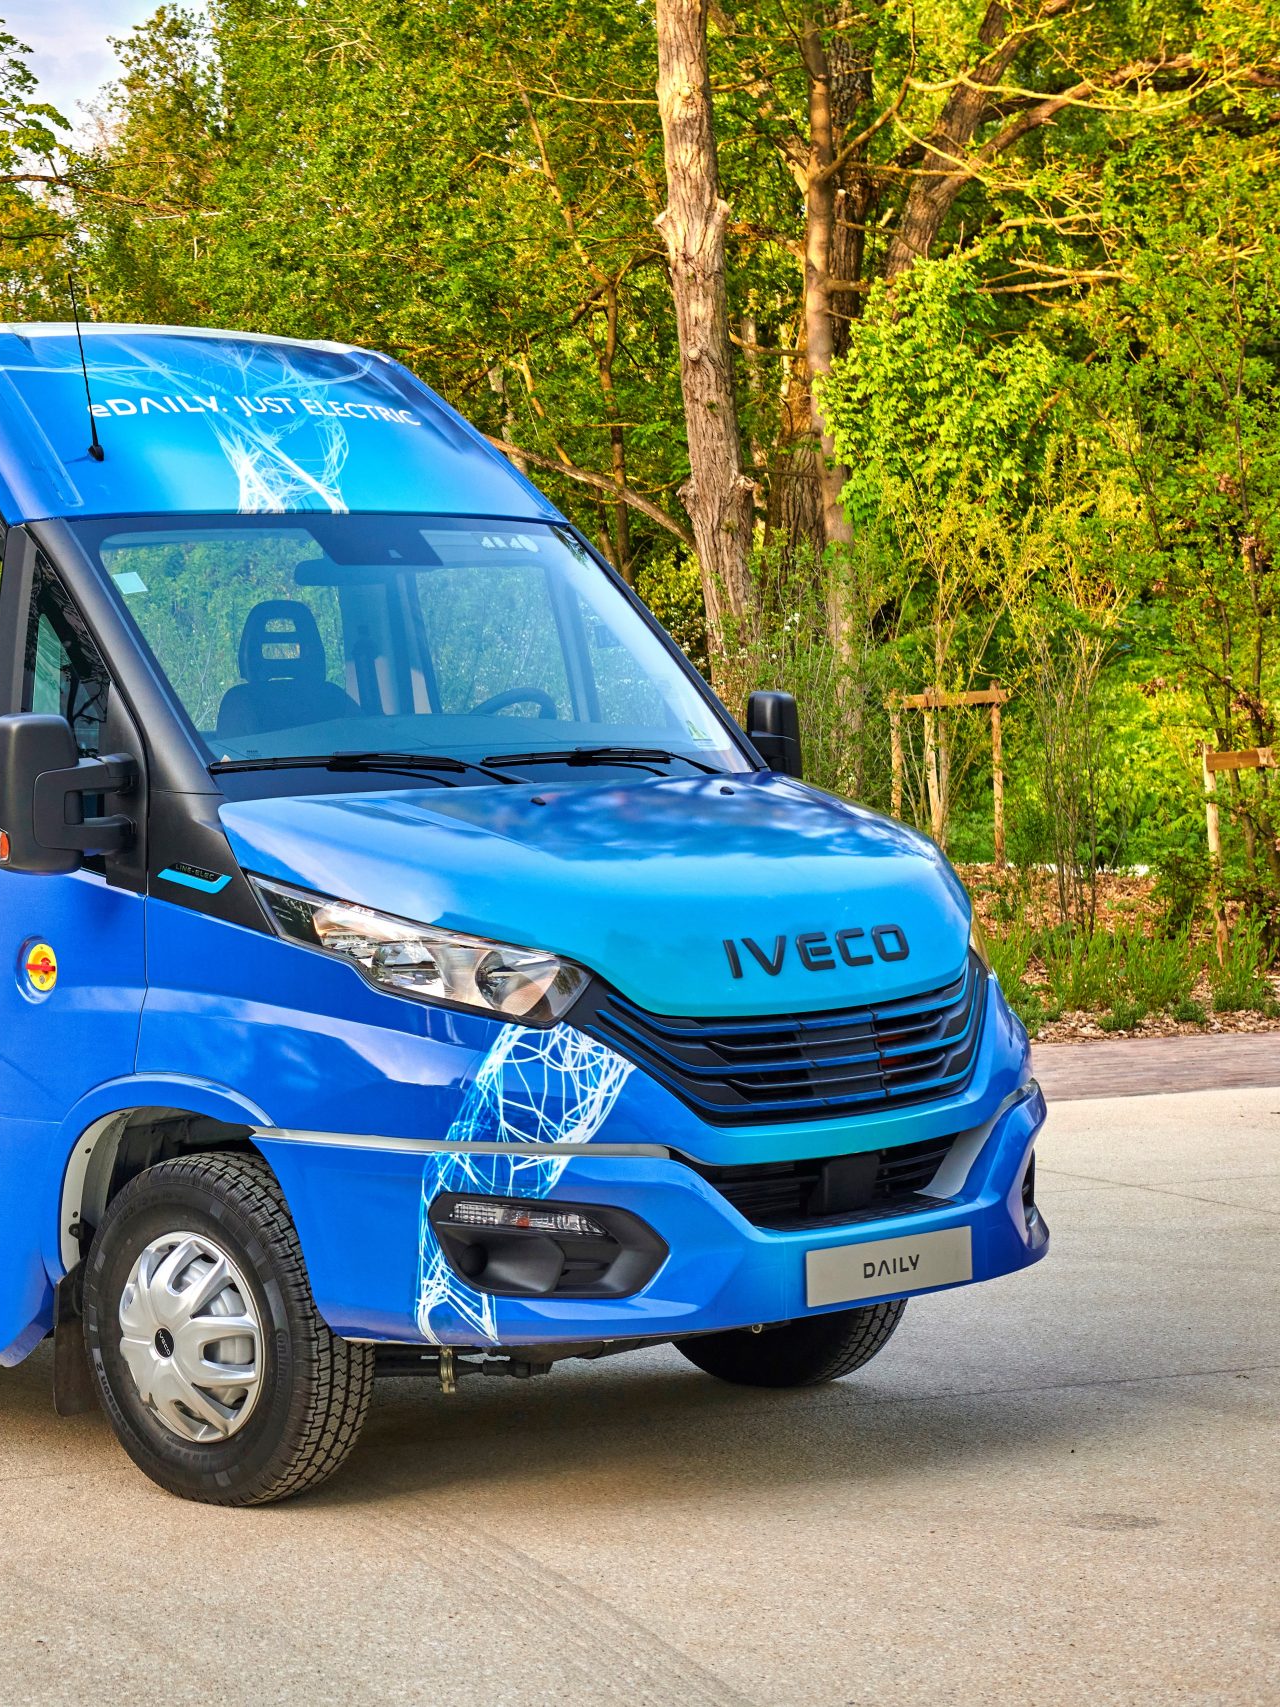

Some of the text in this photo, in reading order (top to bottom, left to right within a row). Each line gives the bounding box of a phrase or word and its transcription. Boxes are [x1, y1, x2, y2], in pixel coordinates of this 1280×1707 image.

[234, 396, 296, 417] JUST
[305, 399, 422, 426] ELECTRIC
[723, 923, 910, 979] IVECO
[863, 1253, 920, 1280] DAILY
[158, 1330, 171, 1356] IVECO
